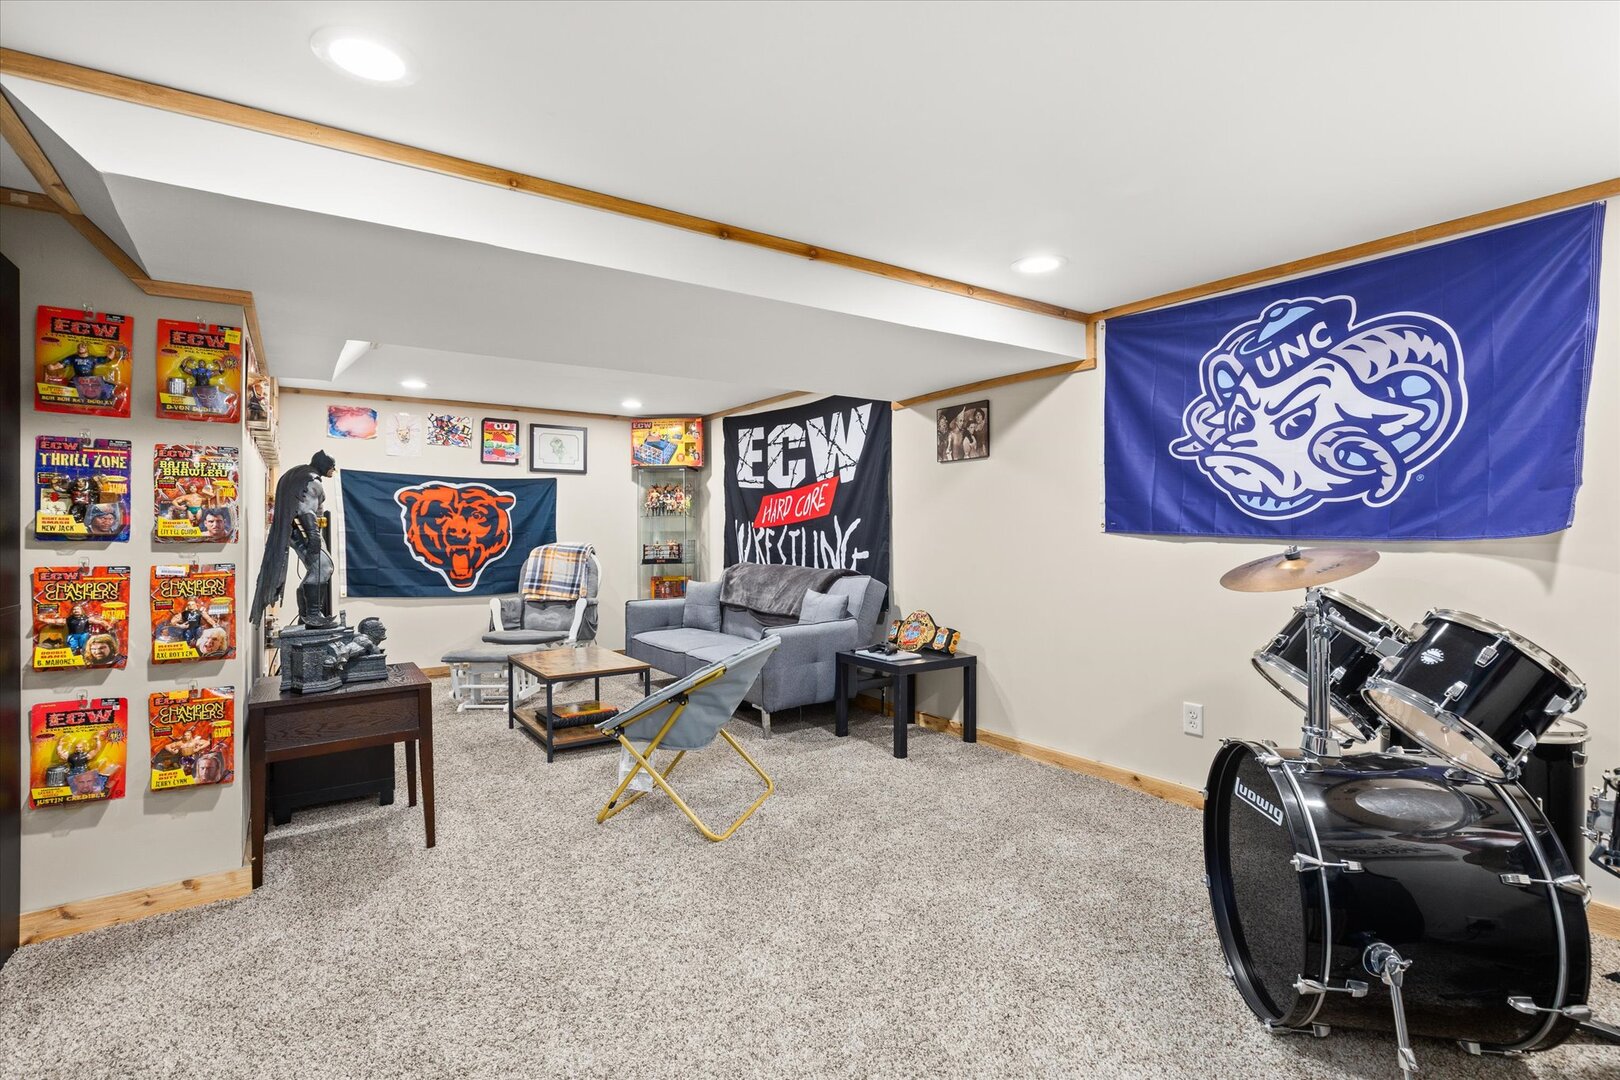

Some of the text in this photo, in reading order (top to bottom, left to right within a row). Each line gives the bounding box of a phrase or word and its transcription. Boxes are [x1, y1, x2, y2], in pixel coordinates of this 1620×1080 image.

[53, 318, 117, 338] ECW
[172, 331, 225, 348] ECW
[1255, 321, 1332, 378] UNC
[40, 441, 78, 450] ECW
[737, 403, 872, 489] ECW
[158, 449, 191, 458] ECW
[40, 452, 127, 469] THRILL ZONE
[160, 460, 233, 471] BASH OF THE
[163, 468, 229, 477] BRAWLERS
[762, 484, 828, 524] HARD CORE
[735, 515, 869, 571] WRESTLING
[40, 572, 78, 580] ECW
[45, 582, 119, 593] CHAMPION
[160, 578, 225, 590] CHAMPION
[45, 591, 118, 601] CLASHERS
[161, 587, 225, 598] CLASHERS
[160, 702, 224, 716] CHAMPION
[48, 709, 112, 727] ECW
[160, 710, 224, 724] CLASHERS
[36, 796, 63, 806] JUSTIN
